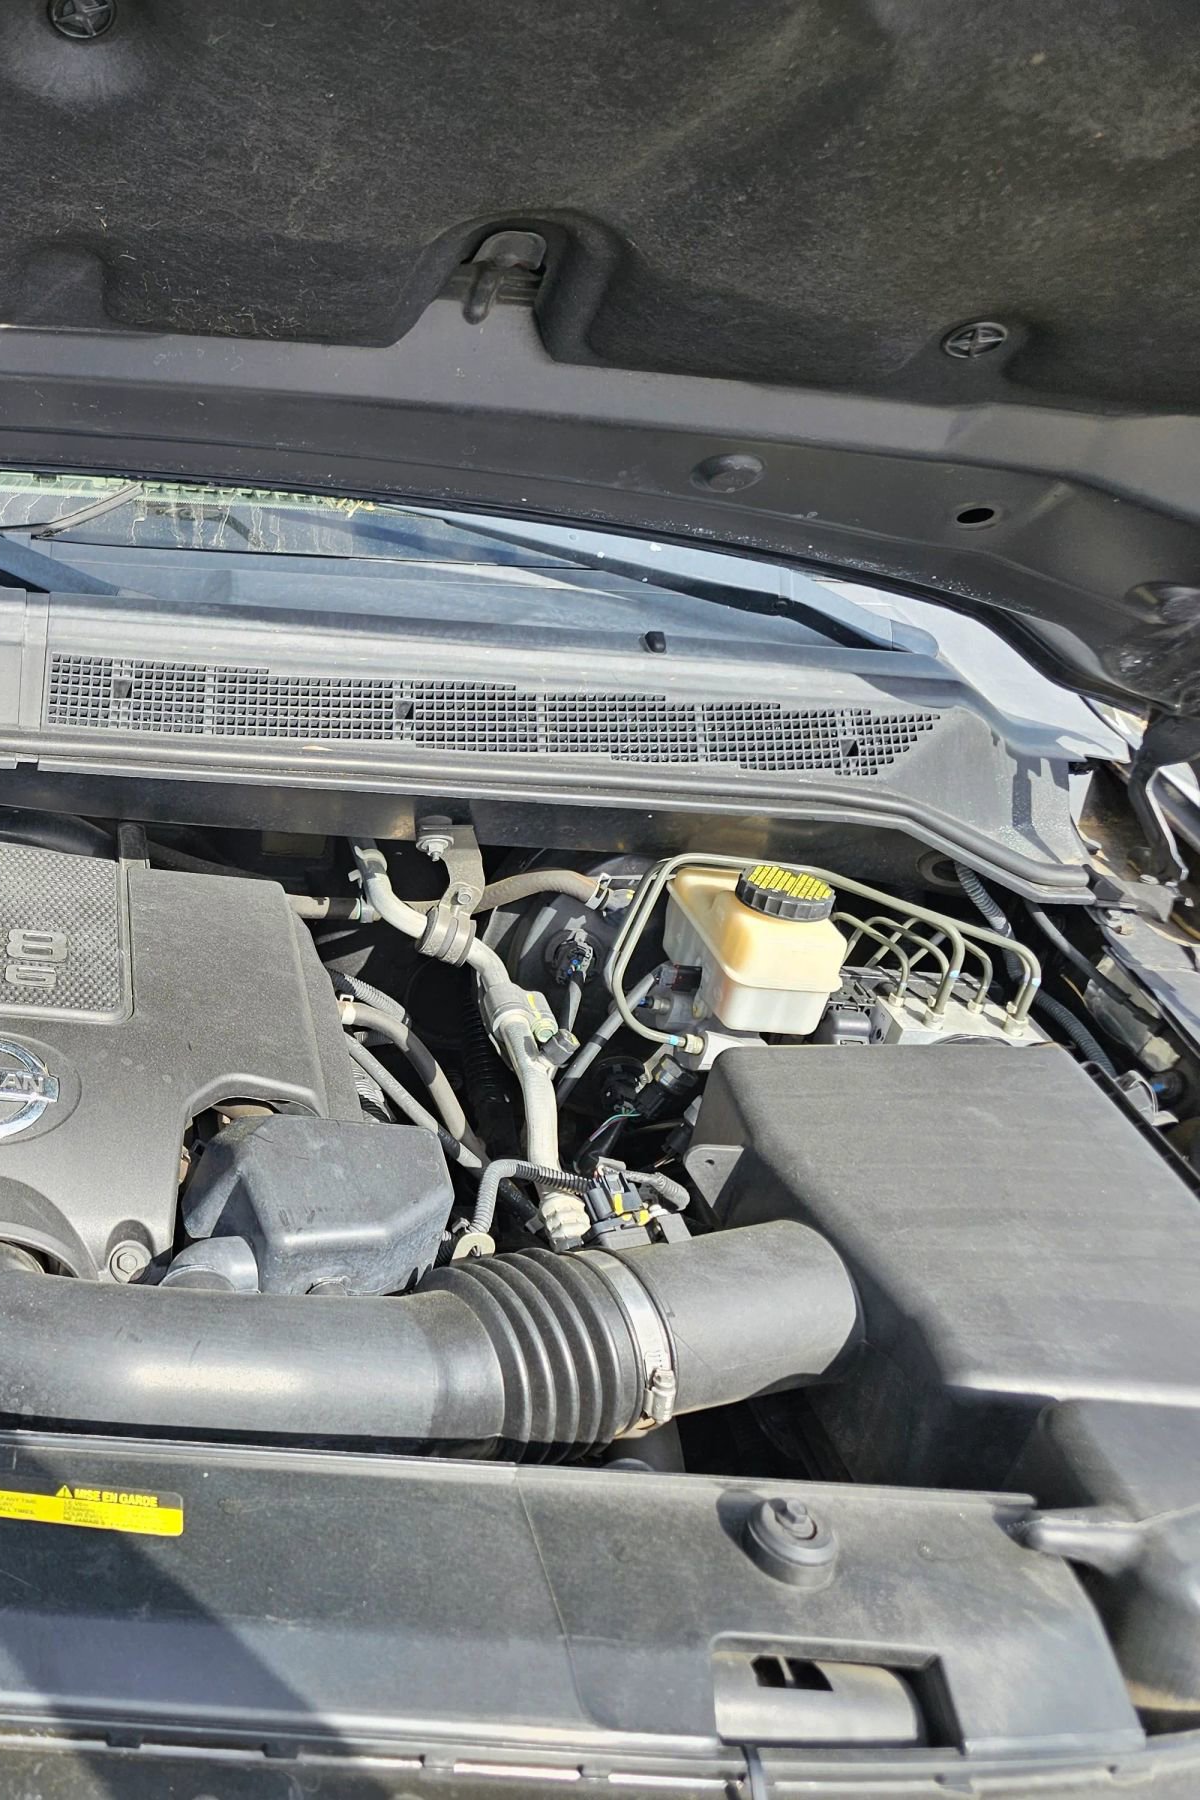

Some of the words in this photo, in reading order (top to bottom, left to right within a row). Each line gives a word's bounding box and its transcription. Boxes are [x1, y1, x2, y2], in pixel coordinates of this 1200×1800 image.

[73, 1488, 102, 1501] MISE
[102, 1490, 118, 1503] EN
[118, 1493, 159, 1507] GARDE
